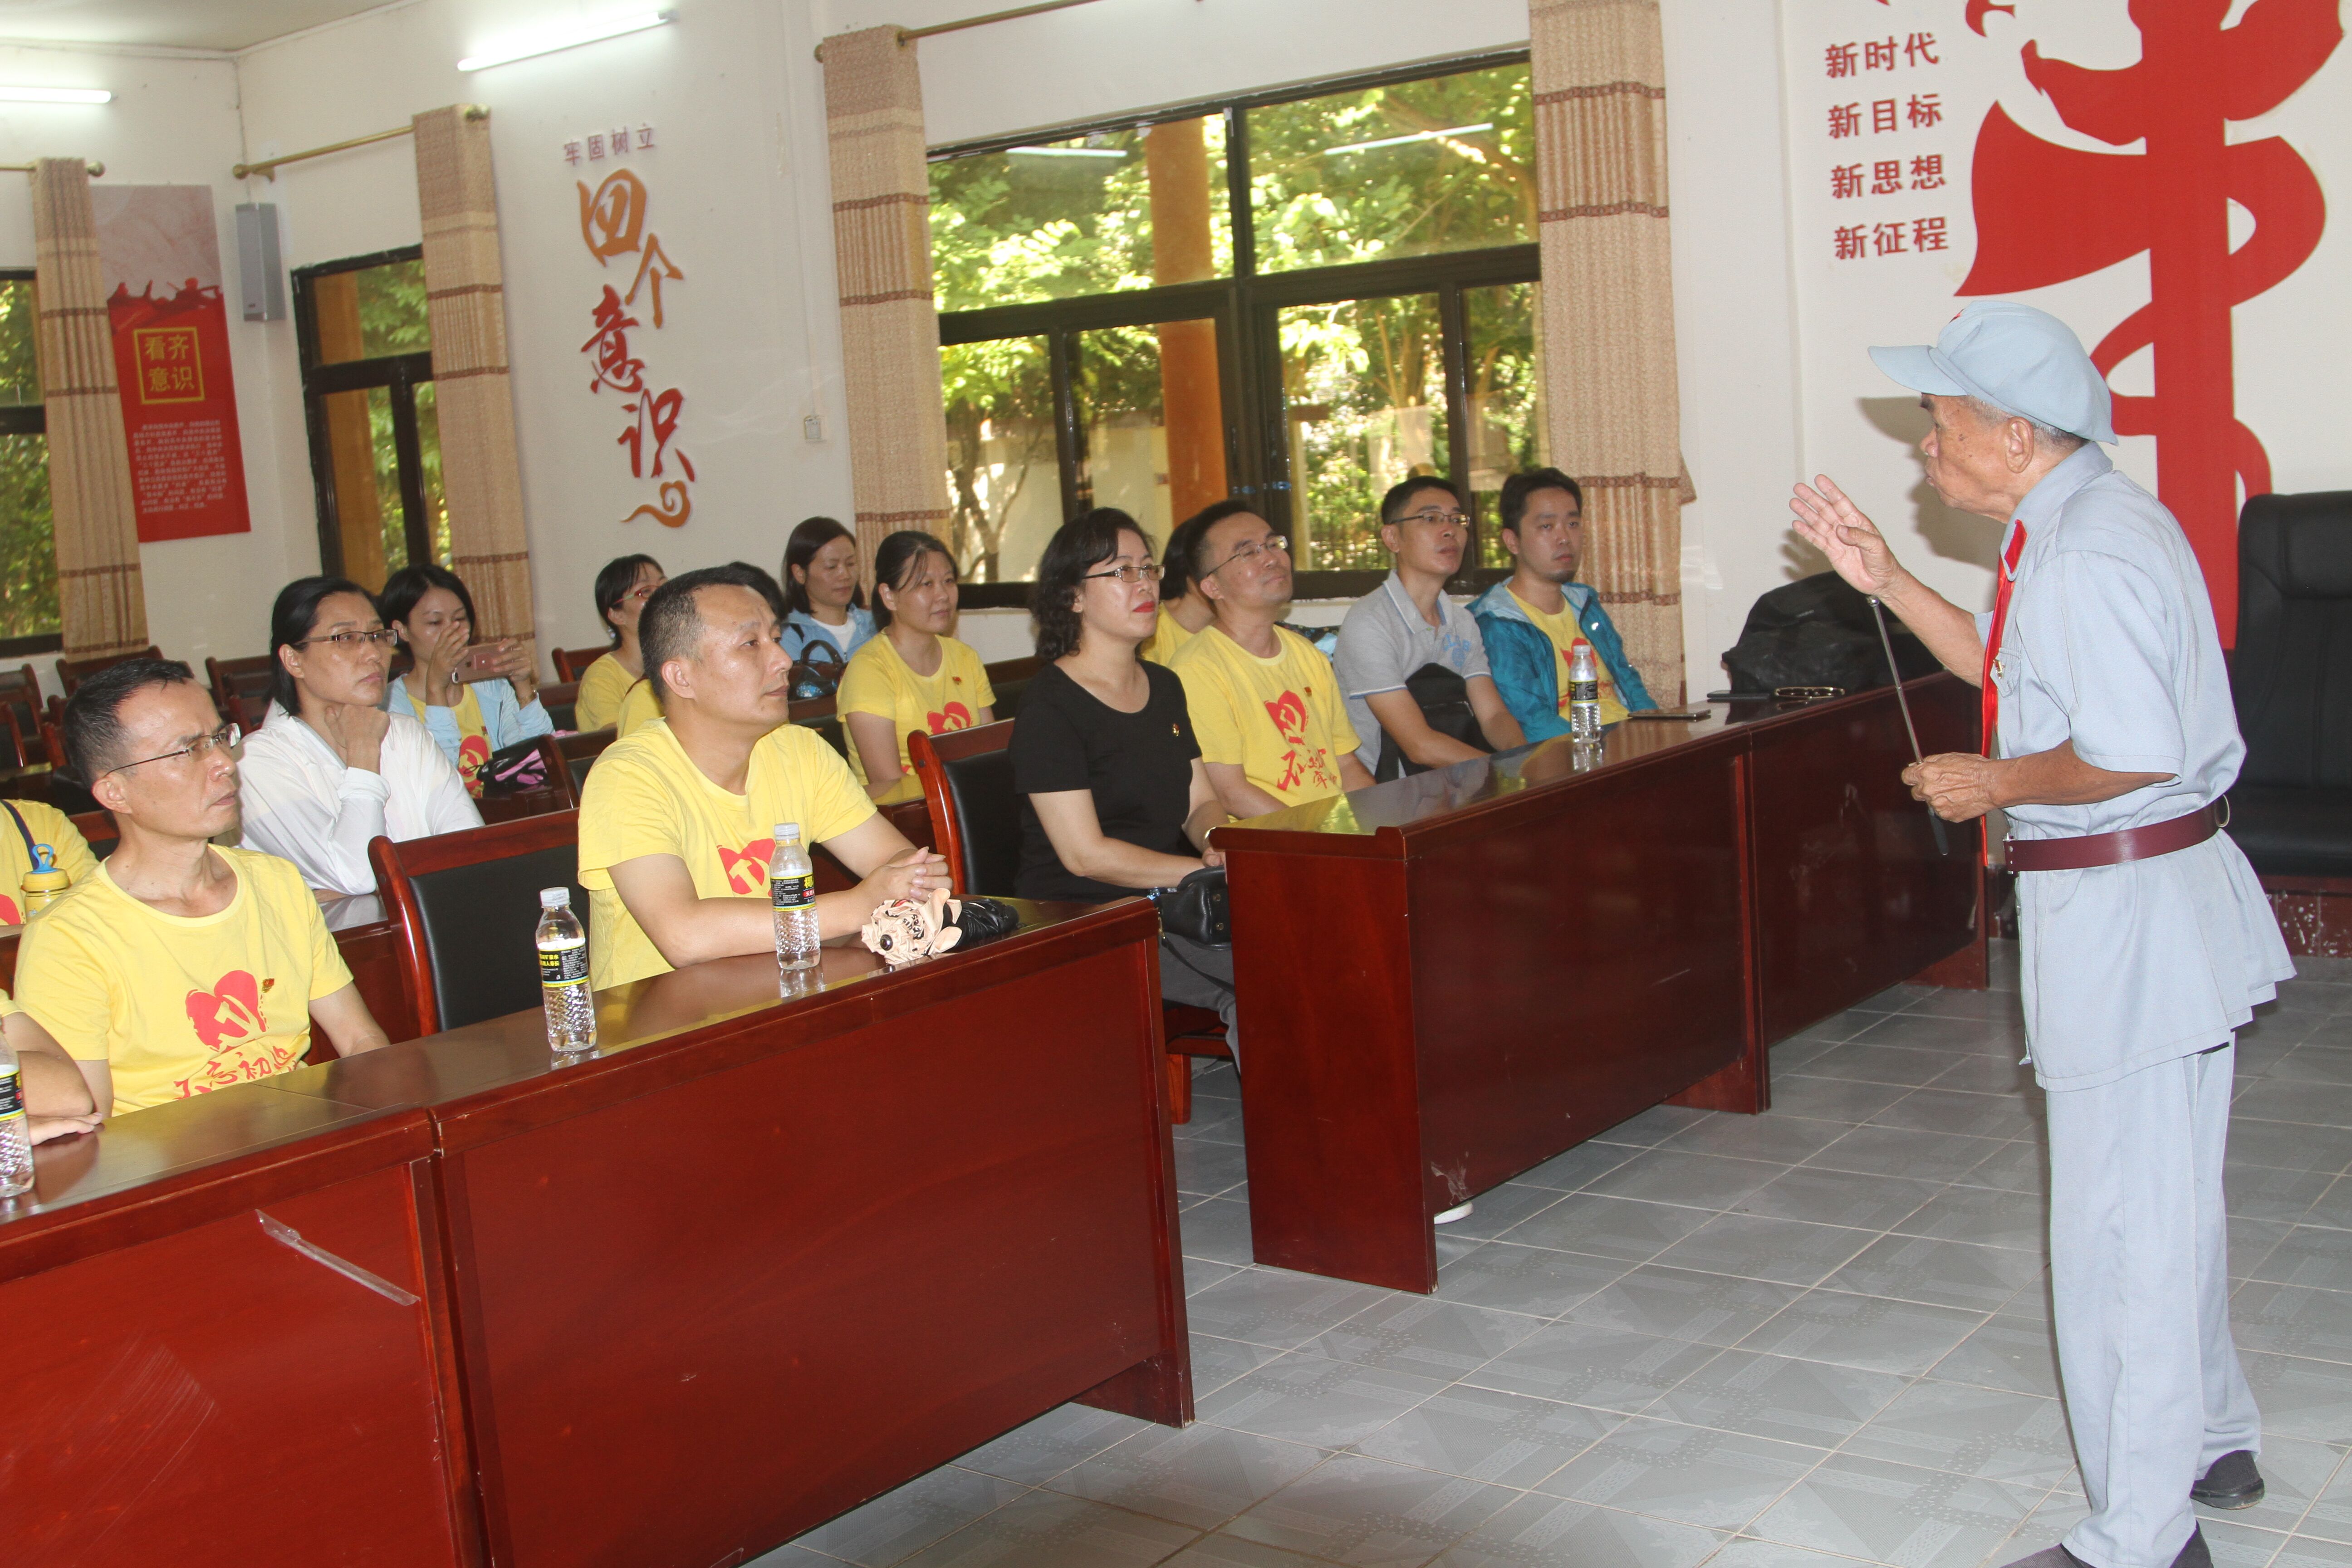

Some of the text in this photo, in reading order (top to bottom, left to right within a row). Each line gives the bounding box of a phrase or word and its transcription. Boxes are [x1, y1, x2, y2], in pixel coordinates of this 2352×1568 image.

[1825, 32, 1939, 78] 新时代
[1828, 93, 1942, 138] 新目标
[563, 122, 655, 166] 牢固树立
[1831, 154, 1945, 199] 新思想
[1834, 216, 1949, 260] 新征程
[576, 168, 695, 482] 四个意识
[144, 334, 189, 361] 看齐
[148, 366, 195, 393] 意识
